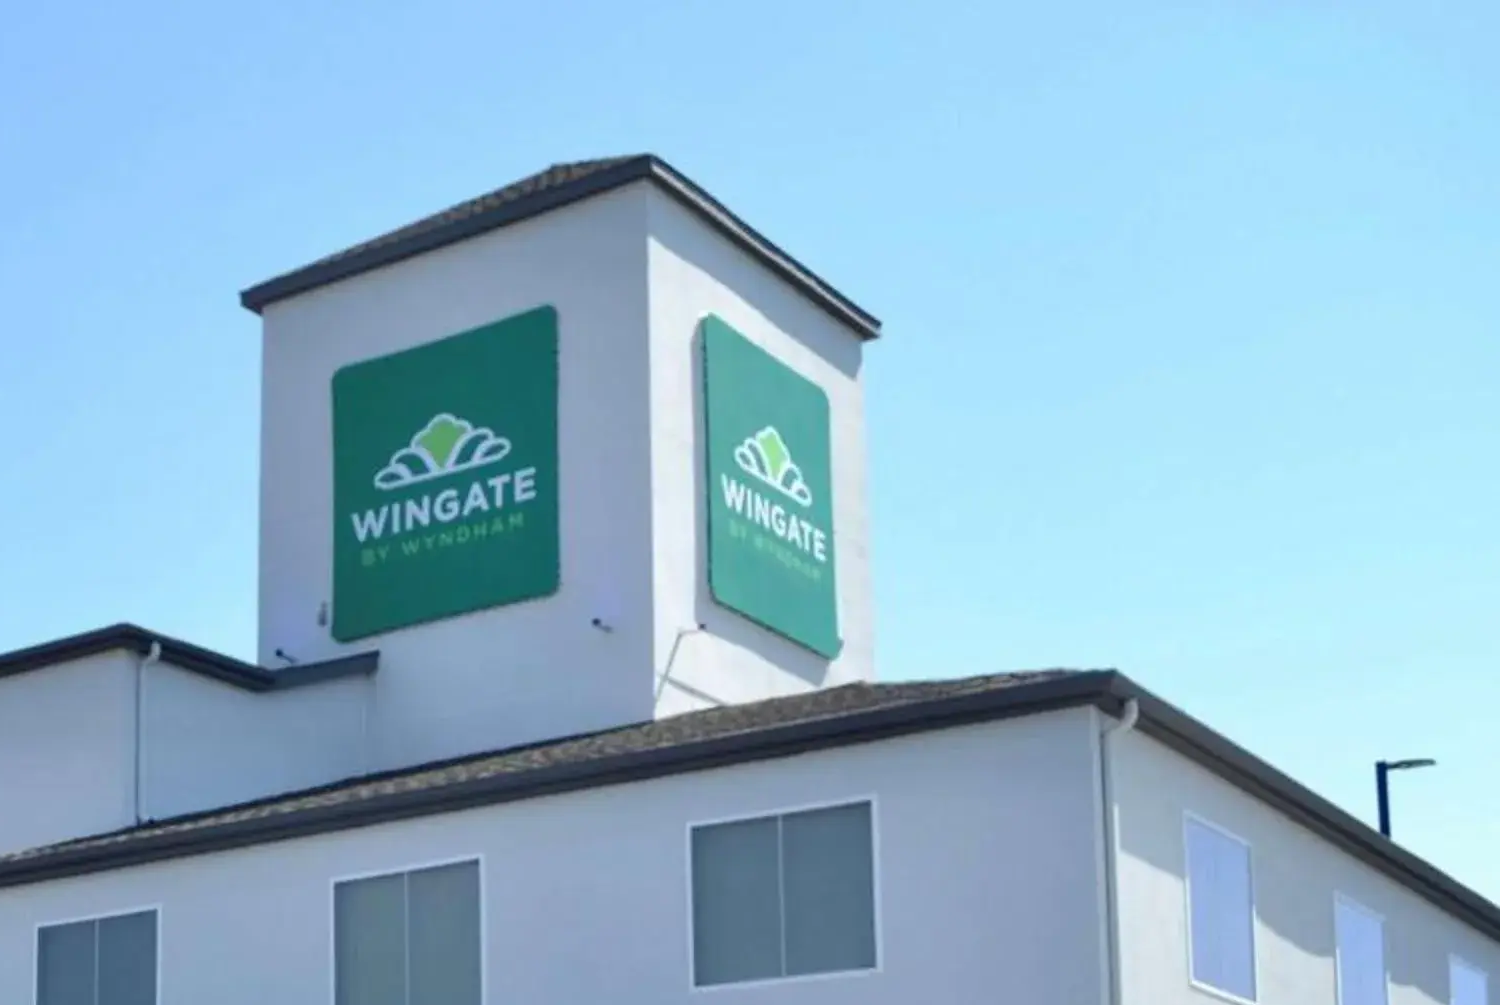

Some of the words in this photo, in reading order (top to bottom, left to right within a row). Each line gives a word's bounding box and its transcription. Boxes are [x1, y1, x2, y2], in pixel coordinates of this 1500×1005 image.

[351, 466, 537, 543] WINGATE
[361, 545, 390, 567] BY
[402, 512, 524, 556] WYNDHAM
[721, 473, 827, 563] WINGATE
